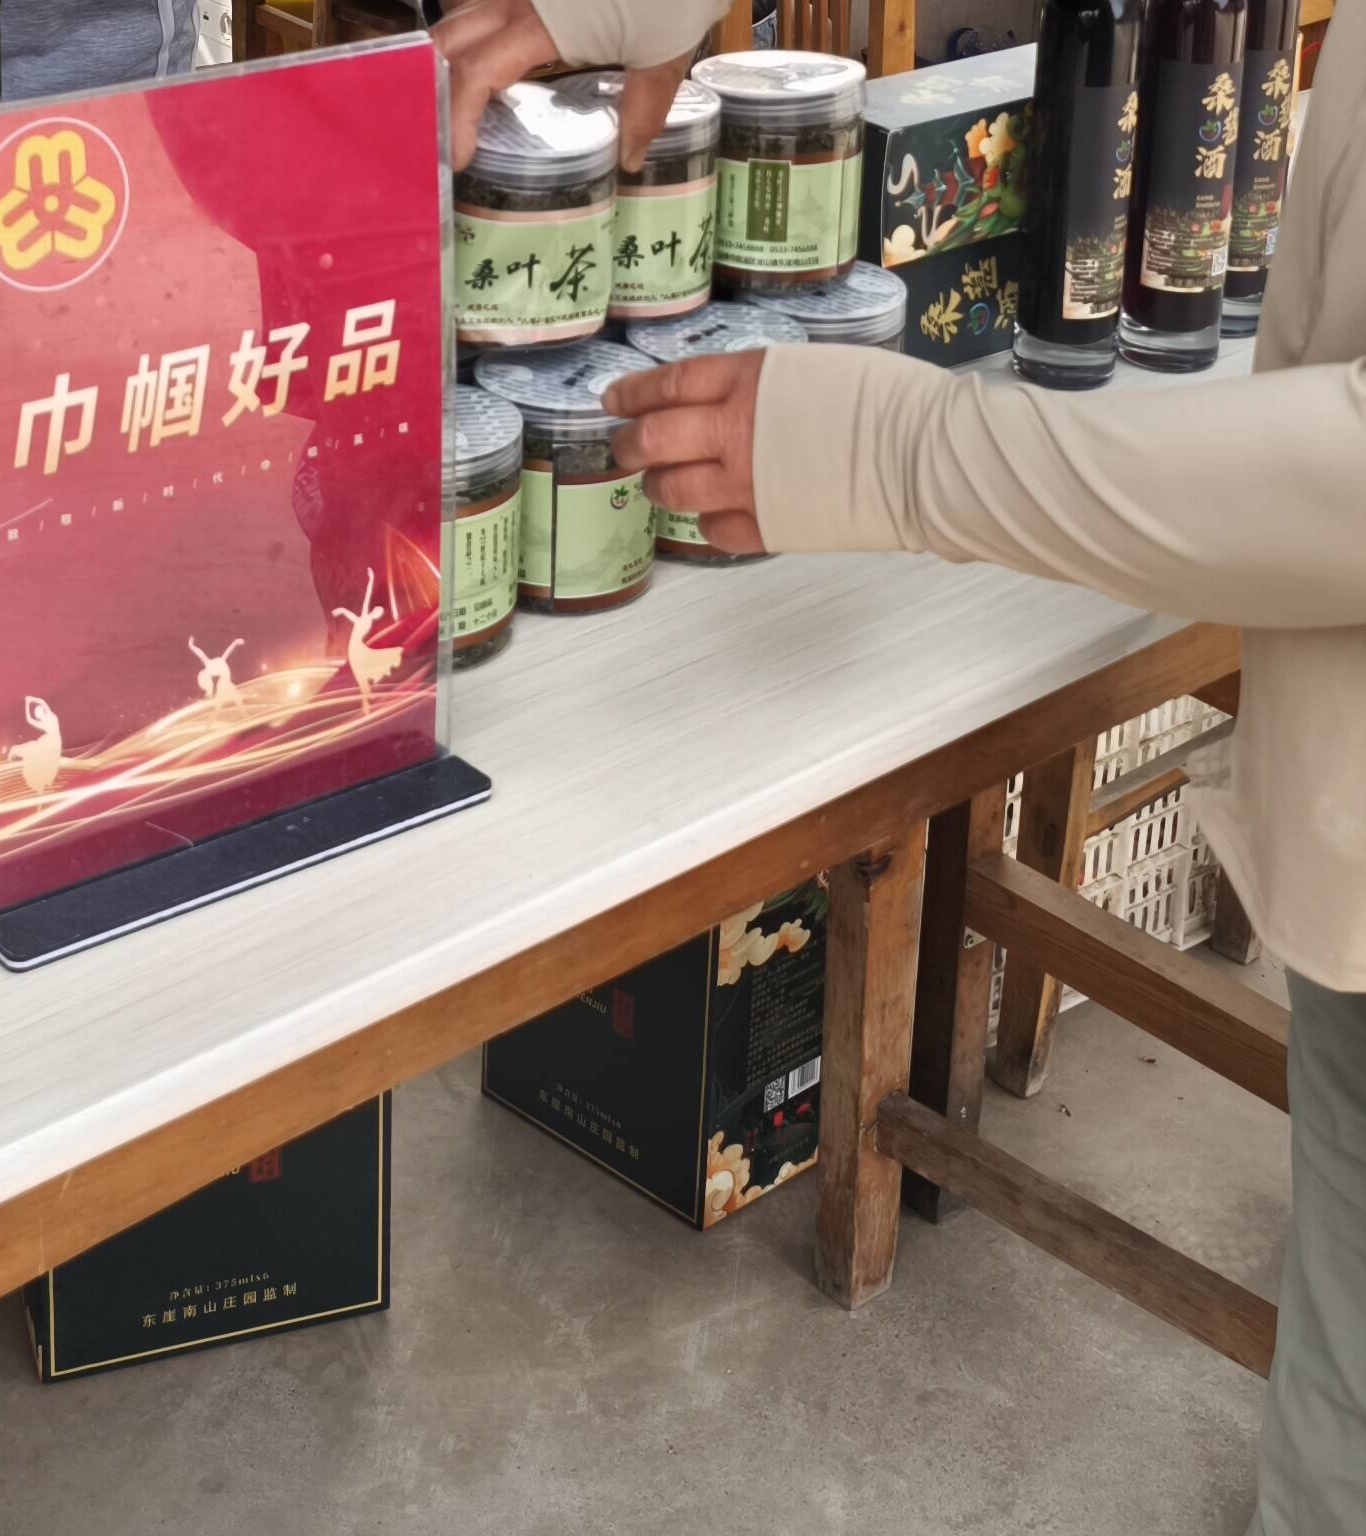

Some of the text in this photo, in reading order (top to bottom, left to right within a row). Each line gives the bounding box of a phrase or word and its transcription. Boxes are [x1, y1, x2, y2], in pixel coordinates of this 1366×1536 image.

[464, 243, 597, 302] 桑叶茶
[13, 300, 401, 476] 巾帼好品
[141, 1281, 298, 1329] 东崖南山庄园监制
